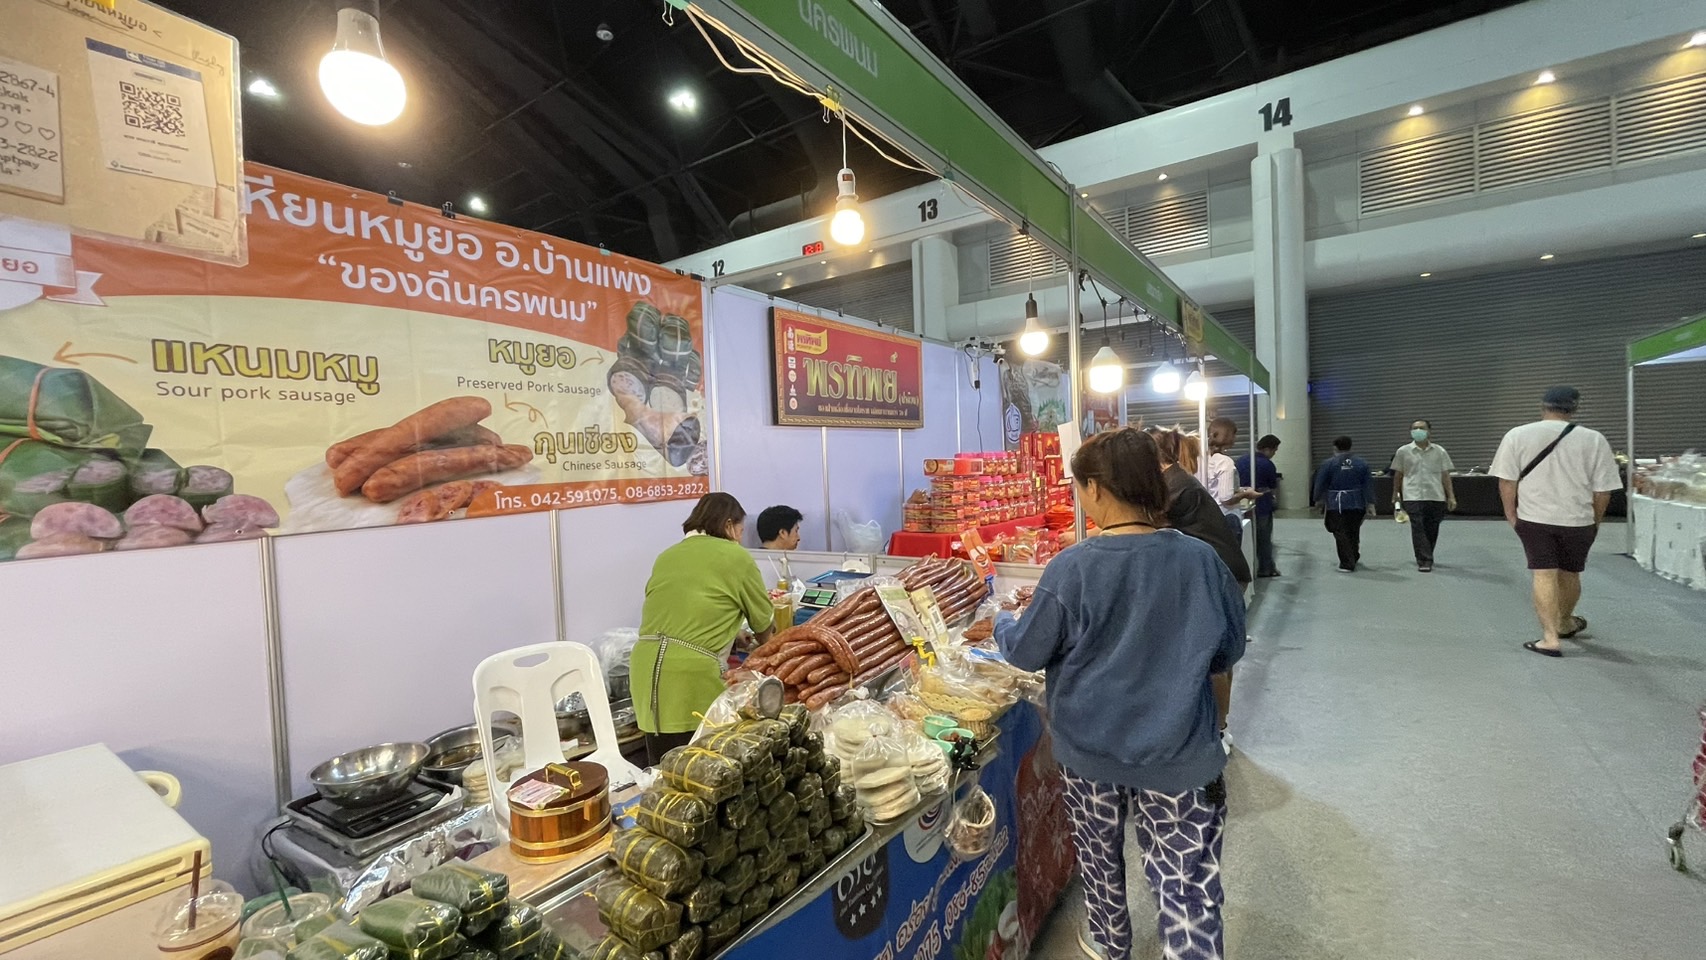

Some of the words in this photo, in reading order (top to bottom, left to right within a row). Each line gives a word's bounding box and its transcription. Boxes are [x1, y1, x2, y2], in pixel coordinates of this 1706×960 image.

[1258, 97, 1293, 132] 14
[918, 199, 938, 222] 13
[496, 240, 651, 295] อ.บ้านแพง
[712, 259, 725, 277] 12
[318, 254, 597, 322] “ของดีนครพนม”
[152, 339, 380, 395] แหนมหมู
[488, 338, 576, 375] หมูยอ
[156, 381, 212, 397] Sour
[221, 384, 271, 401] pork
[279, 389, 356, 405] sausage
[457, 376, 523, 391] Preserved
[528, 380, 554, 392] Pork
[557, 383, 602, 397] Sausage
[803, 352, 898, 403] พรทิพย์
[534, 424, 638, 464] กุนเชียง
[562, 460, 602, 471] Chinese
[605, 459, 647, 470] Sausage
